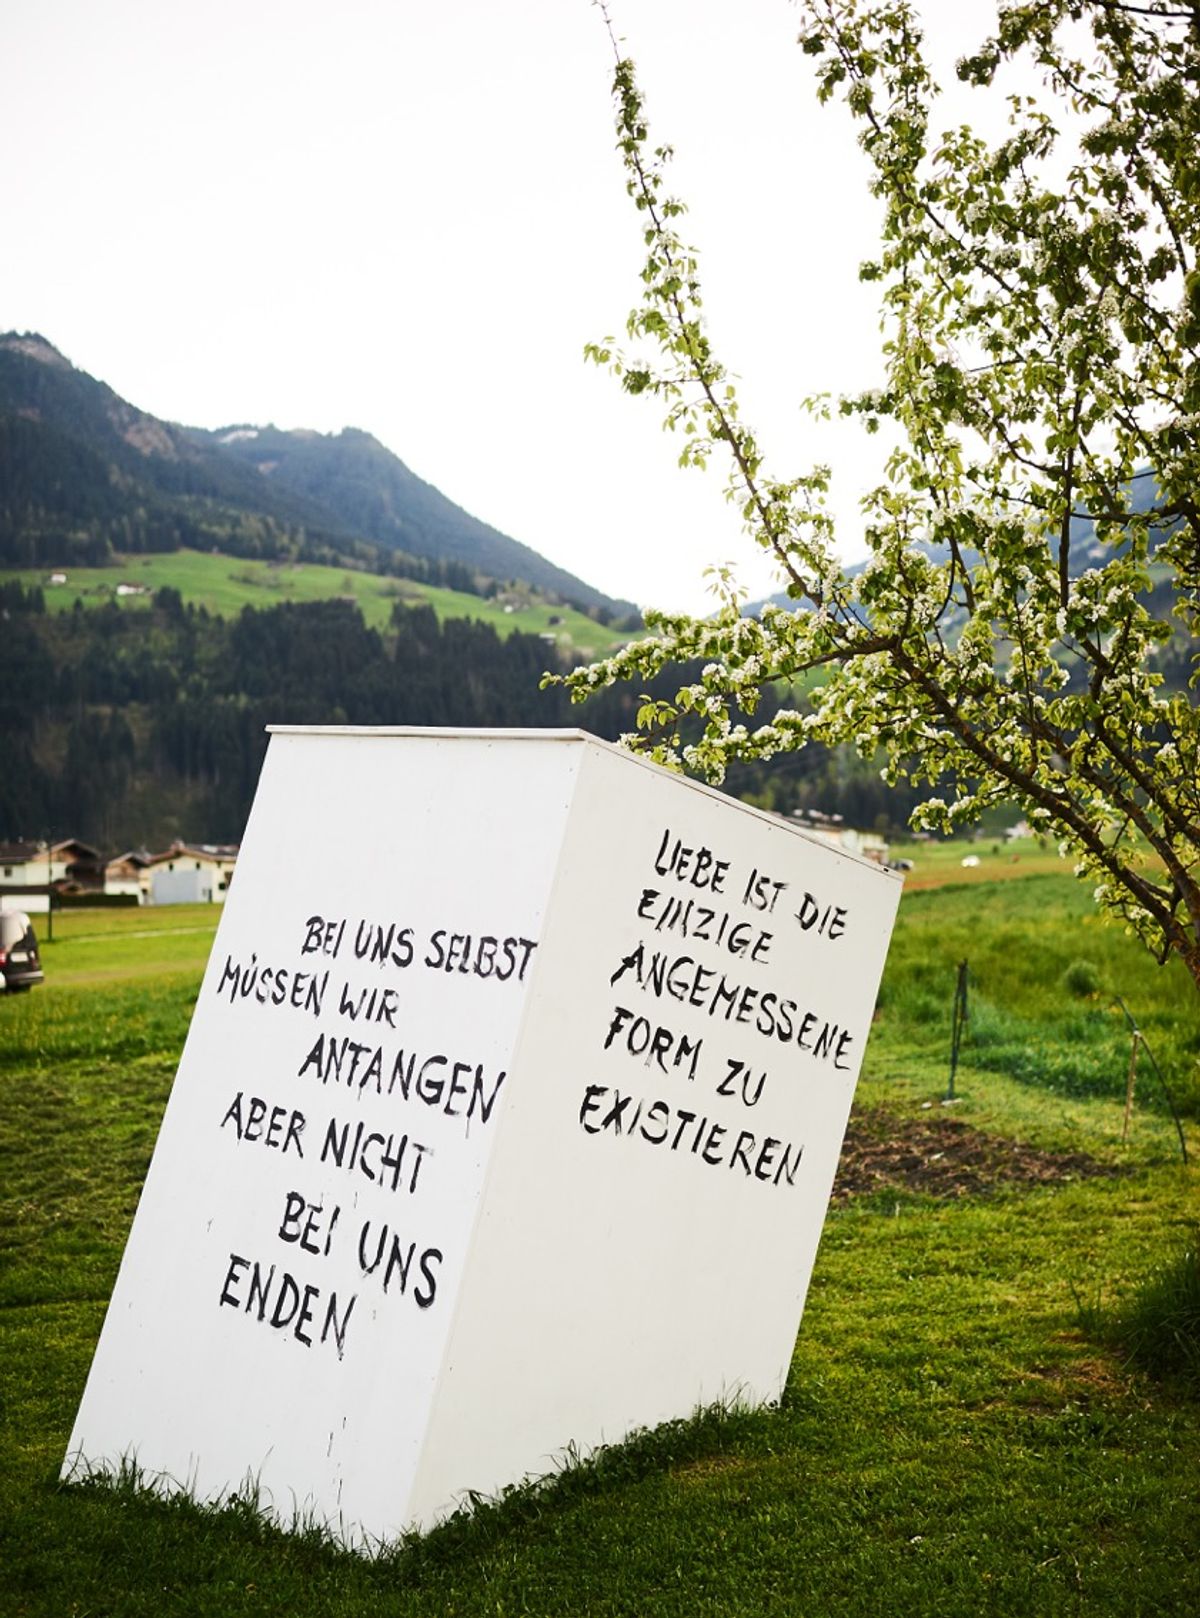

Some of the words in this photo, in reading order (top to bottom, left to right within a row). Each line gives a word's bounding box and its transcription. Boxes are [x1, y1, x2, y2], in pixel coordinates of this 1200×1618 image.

[655, 829, 731, 894] LIEBE
[743, 868, 789, 913] IST
[794, 892, 848, 940] DIE
[301, 915, 347, 959] BEI
[355, 919, 415, 968] UNS
[424, 930, 538, 981] SELBST
[339, 982, 400, 1029] WIR
[610, 940, 853, 1070] ANGEMESSENE
[603, 1006, 704, 1081] FORM
[716, 1058, 767, 1107] ZU
[220, 1092, 306, 1159] ABER
[320, 1117, 434, 1194] NICHT
[579, 1084, 804, 1186] EXISTIEREN
[278, 1191, 341, 1257] BEI
[358, 1220, 444, 1309] UNS
[219, 1253, 357, 1358] ENDEN
